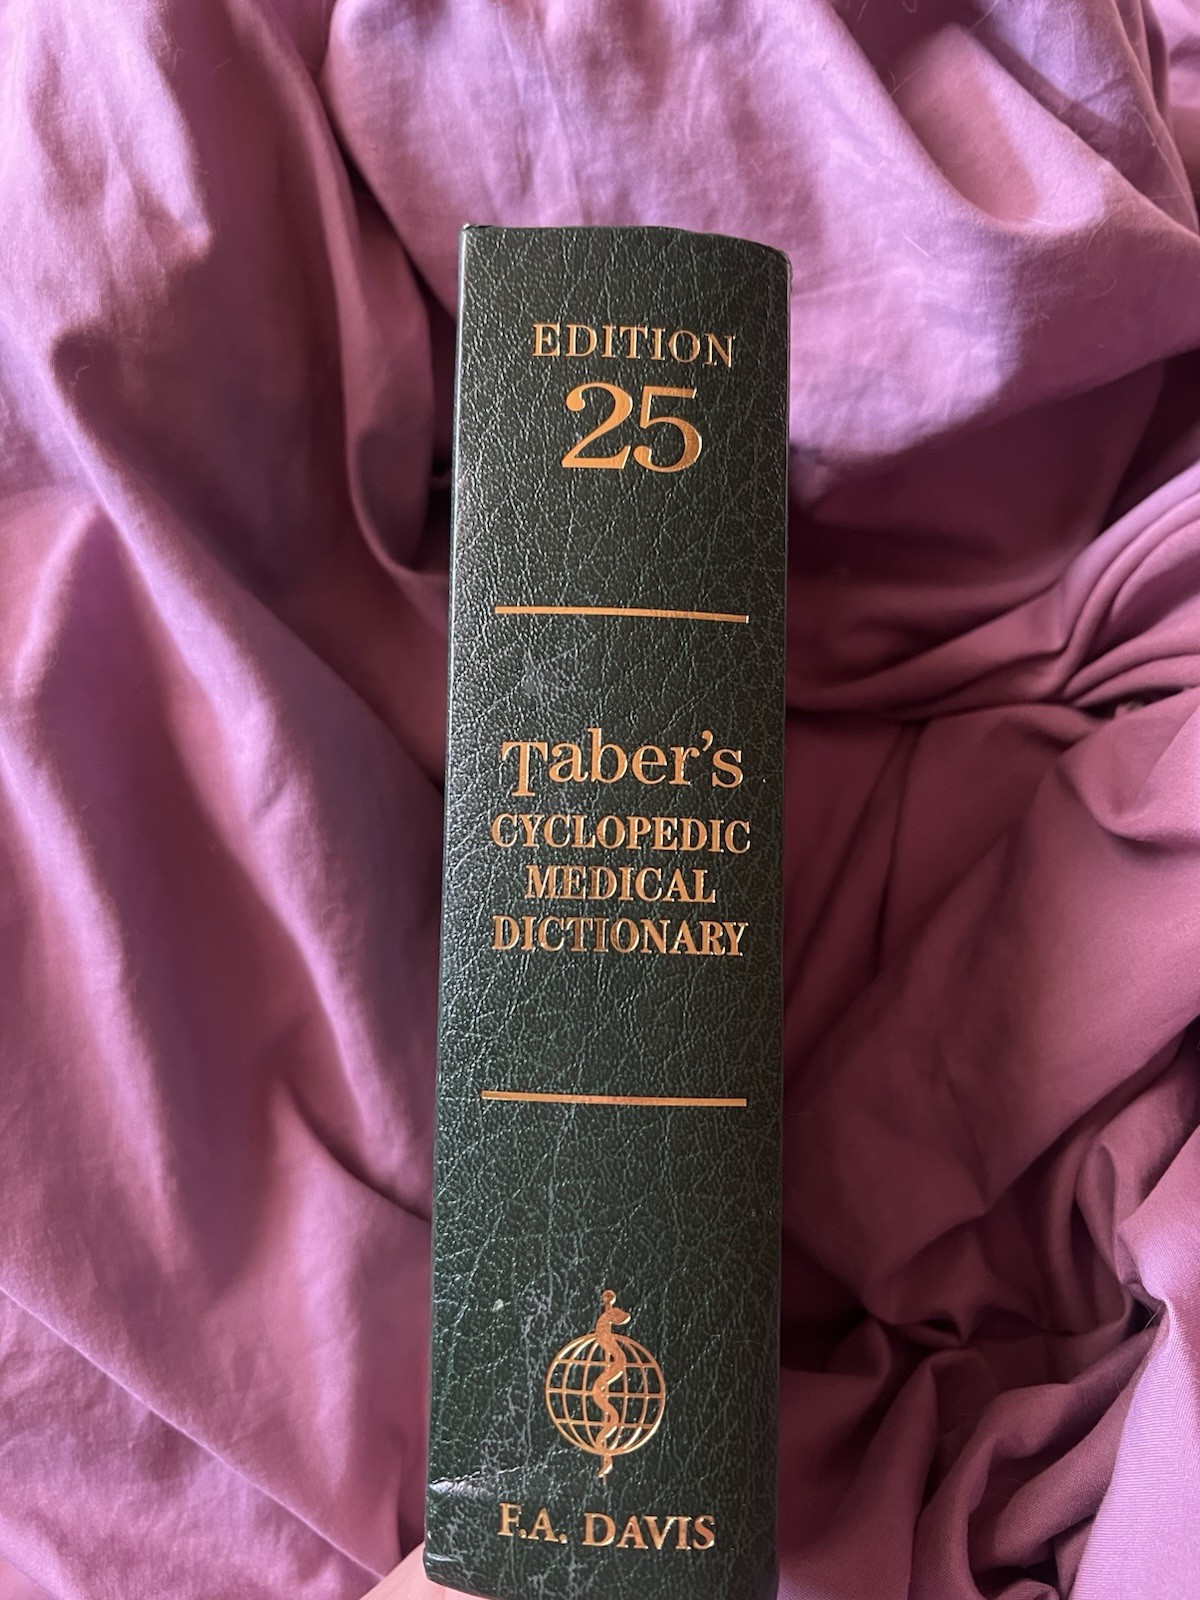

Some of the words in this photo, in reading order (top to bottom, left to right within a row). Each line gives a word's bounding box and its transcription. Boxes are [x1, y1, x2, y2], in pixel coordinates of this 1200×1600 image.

[533, 322, 735, 367] EDITION
[562, 381, 702, 473] 25
[500, 727, 744, 797] Taber's
[491, 813, 751, 854] CYCLOPEDIC
[524, 864, 716, 903] MEDICAL
[492, 914, 749, 956] DICTIONARY
[497, 1502, 567, 1543] F.A.
[582, 1512, 715, 1550] DAVIS
